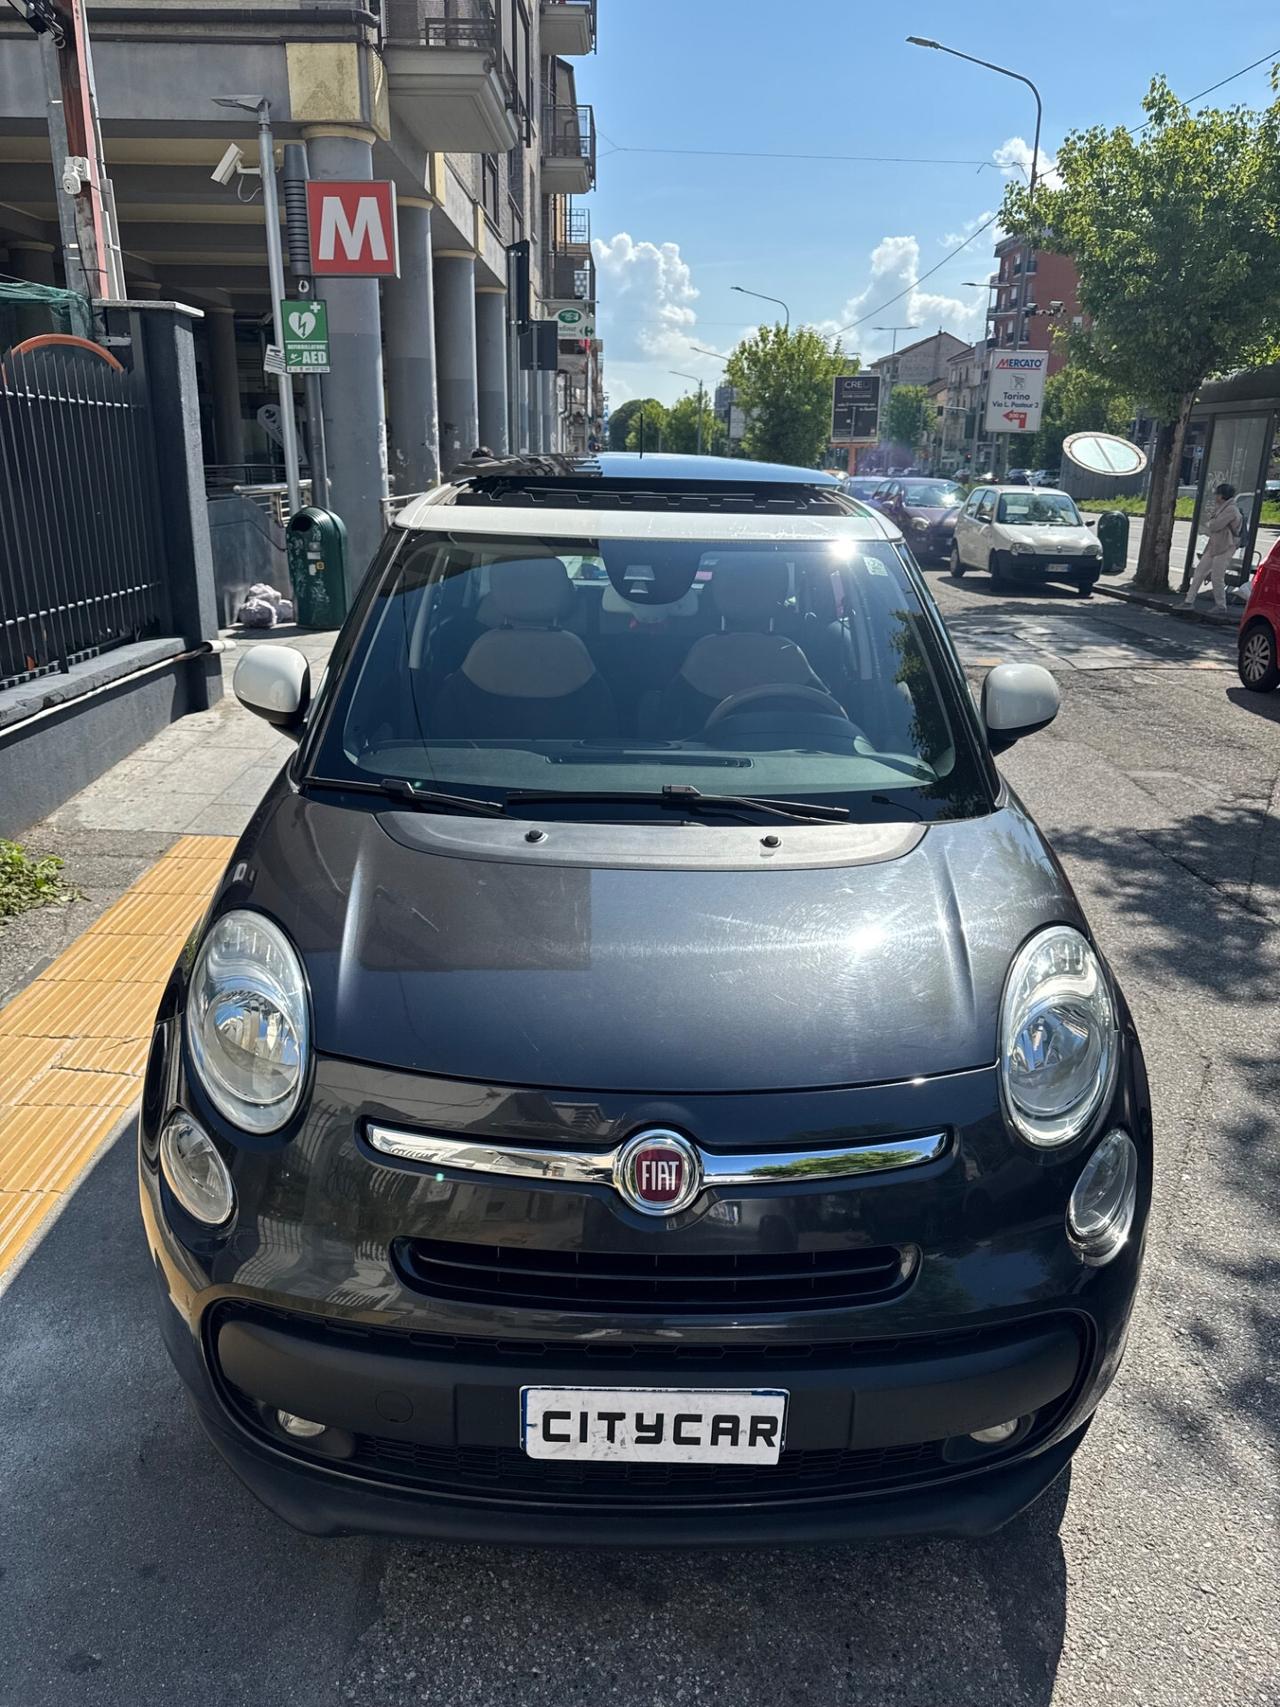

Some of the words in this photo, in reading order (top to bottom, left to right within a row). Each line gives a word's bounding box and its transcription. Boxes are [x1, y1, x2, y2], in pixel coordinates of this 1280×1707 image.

[318, 196, 389, 260] M
[302, 351, 327, 364] AED
[996, 358, 1043, 368] MERCATO
[1003, 391, 1031, 401] Torino
[641, 1160, 680, 1191] FIAT
[542, 1410, 779, 1448] CITYCAR
